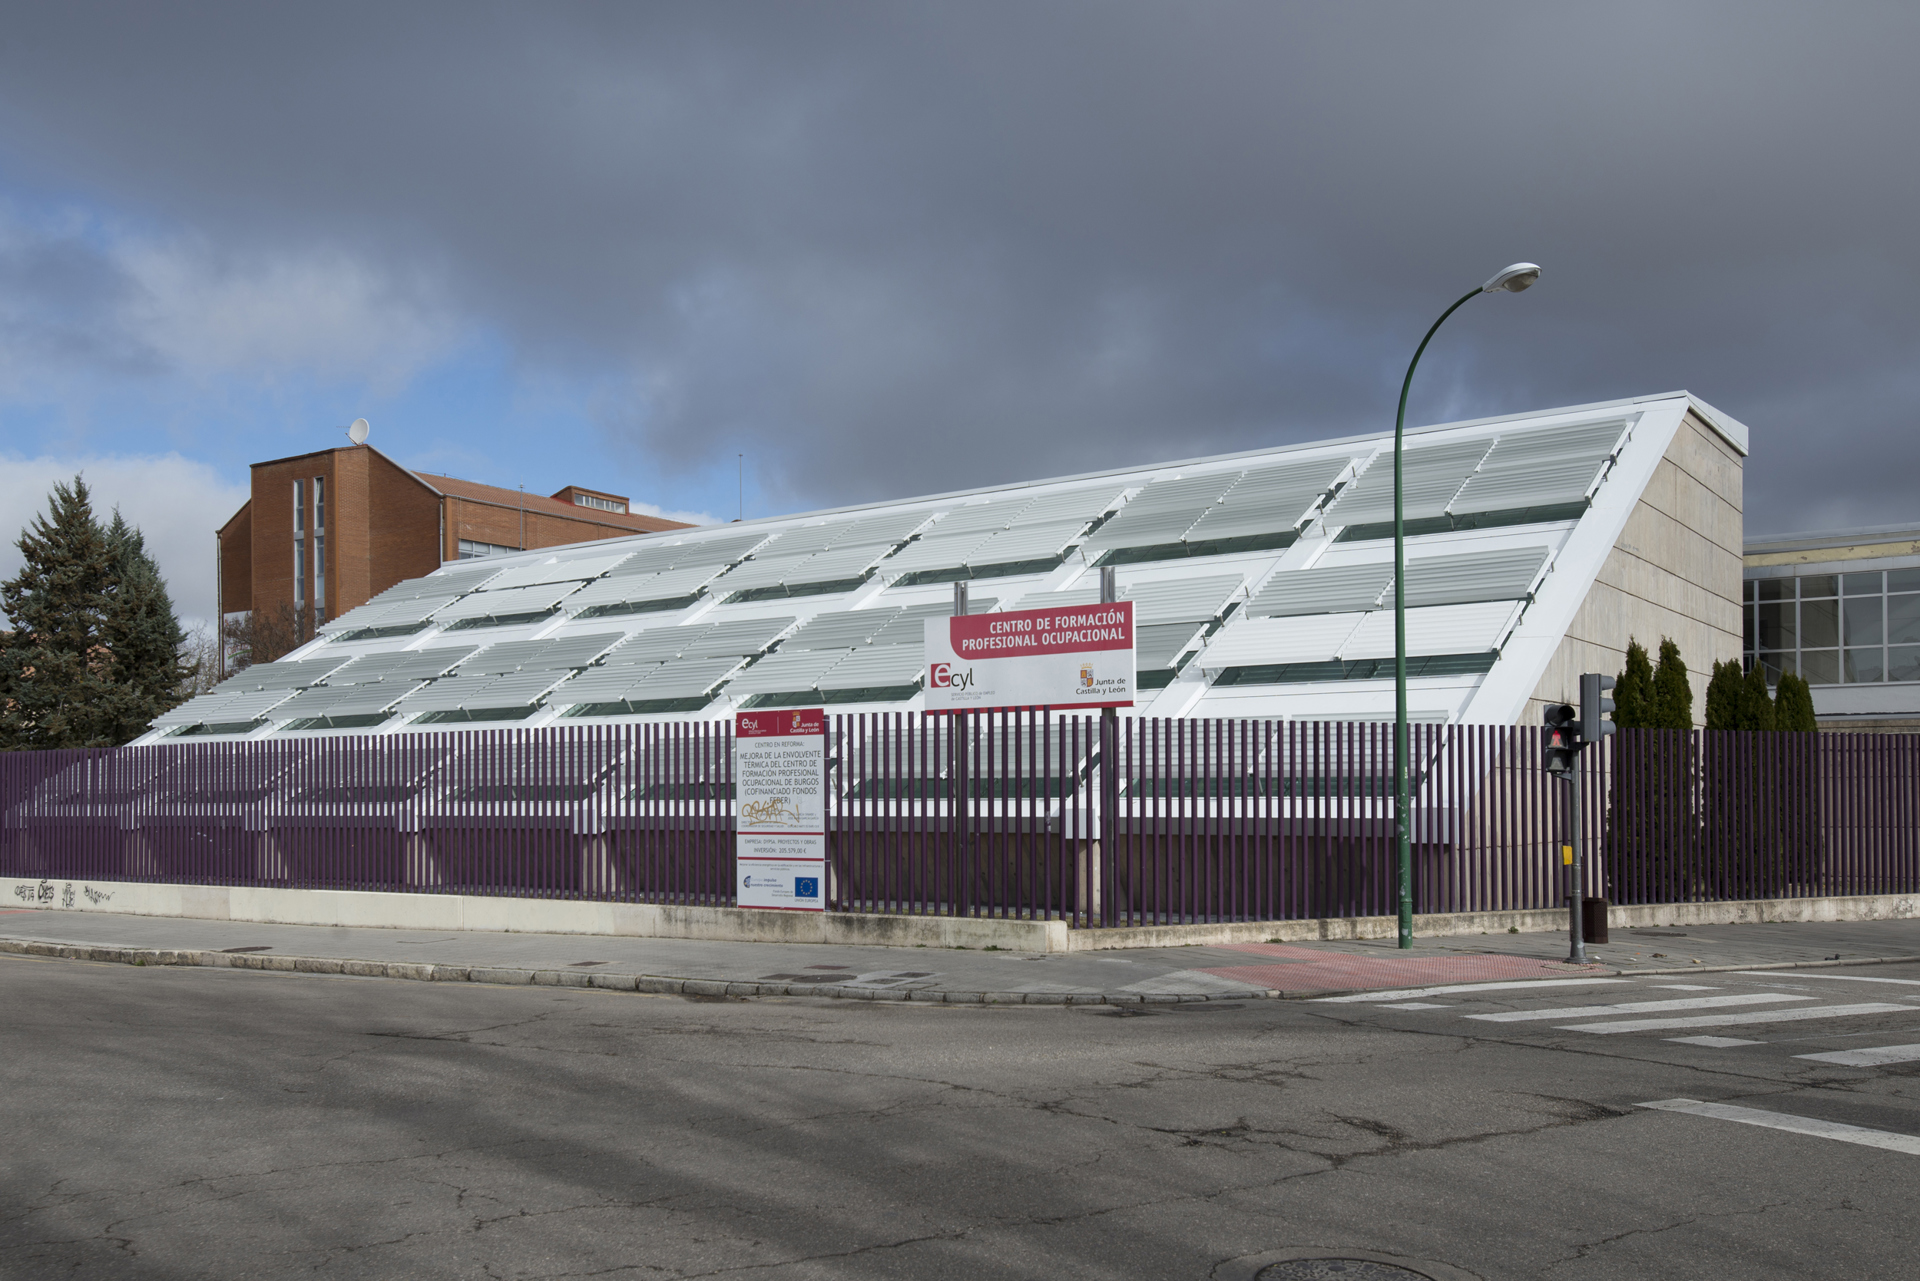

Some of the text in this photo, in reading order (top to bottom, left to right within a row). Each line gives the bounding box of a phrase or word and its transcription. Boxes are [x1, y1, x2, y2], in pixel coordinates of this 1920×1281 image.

[990, 608, 1124, 634] CENTRO DE FORMACIÓN
[962, 627, 1125, 650] PROFESIONAL OCUPACIONAL
[934, 664, 974, 691] ecyl
[1095, 677, 1126, 686] Junta de
[1076, 687, 1100, 695] Castilla
[1108, 686, 1126, 694] León
[742, 718, 758, 730] ecyl
[744, 759, 769, 768] TÉRMICA
[742, 768, 776, 777] FORMACIÓN
[745, 787, 790, 796] (COFINANCIADO
